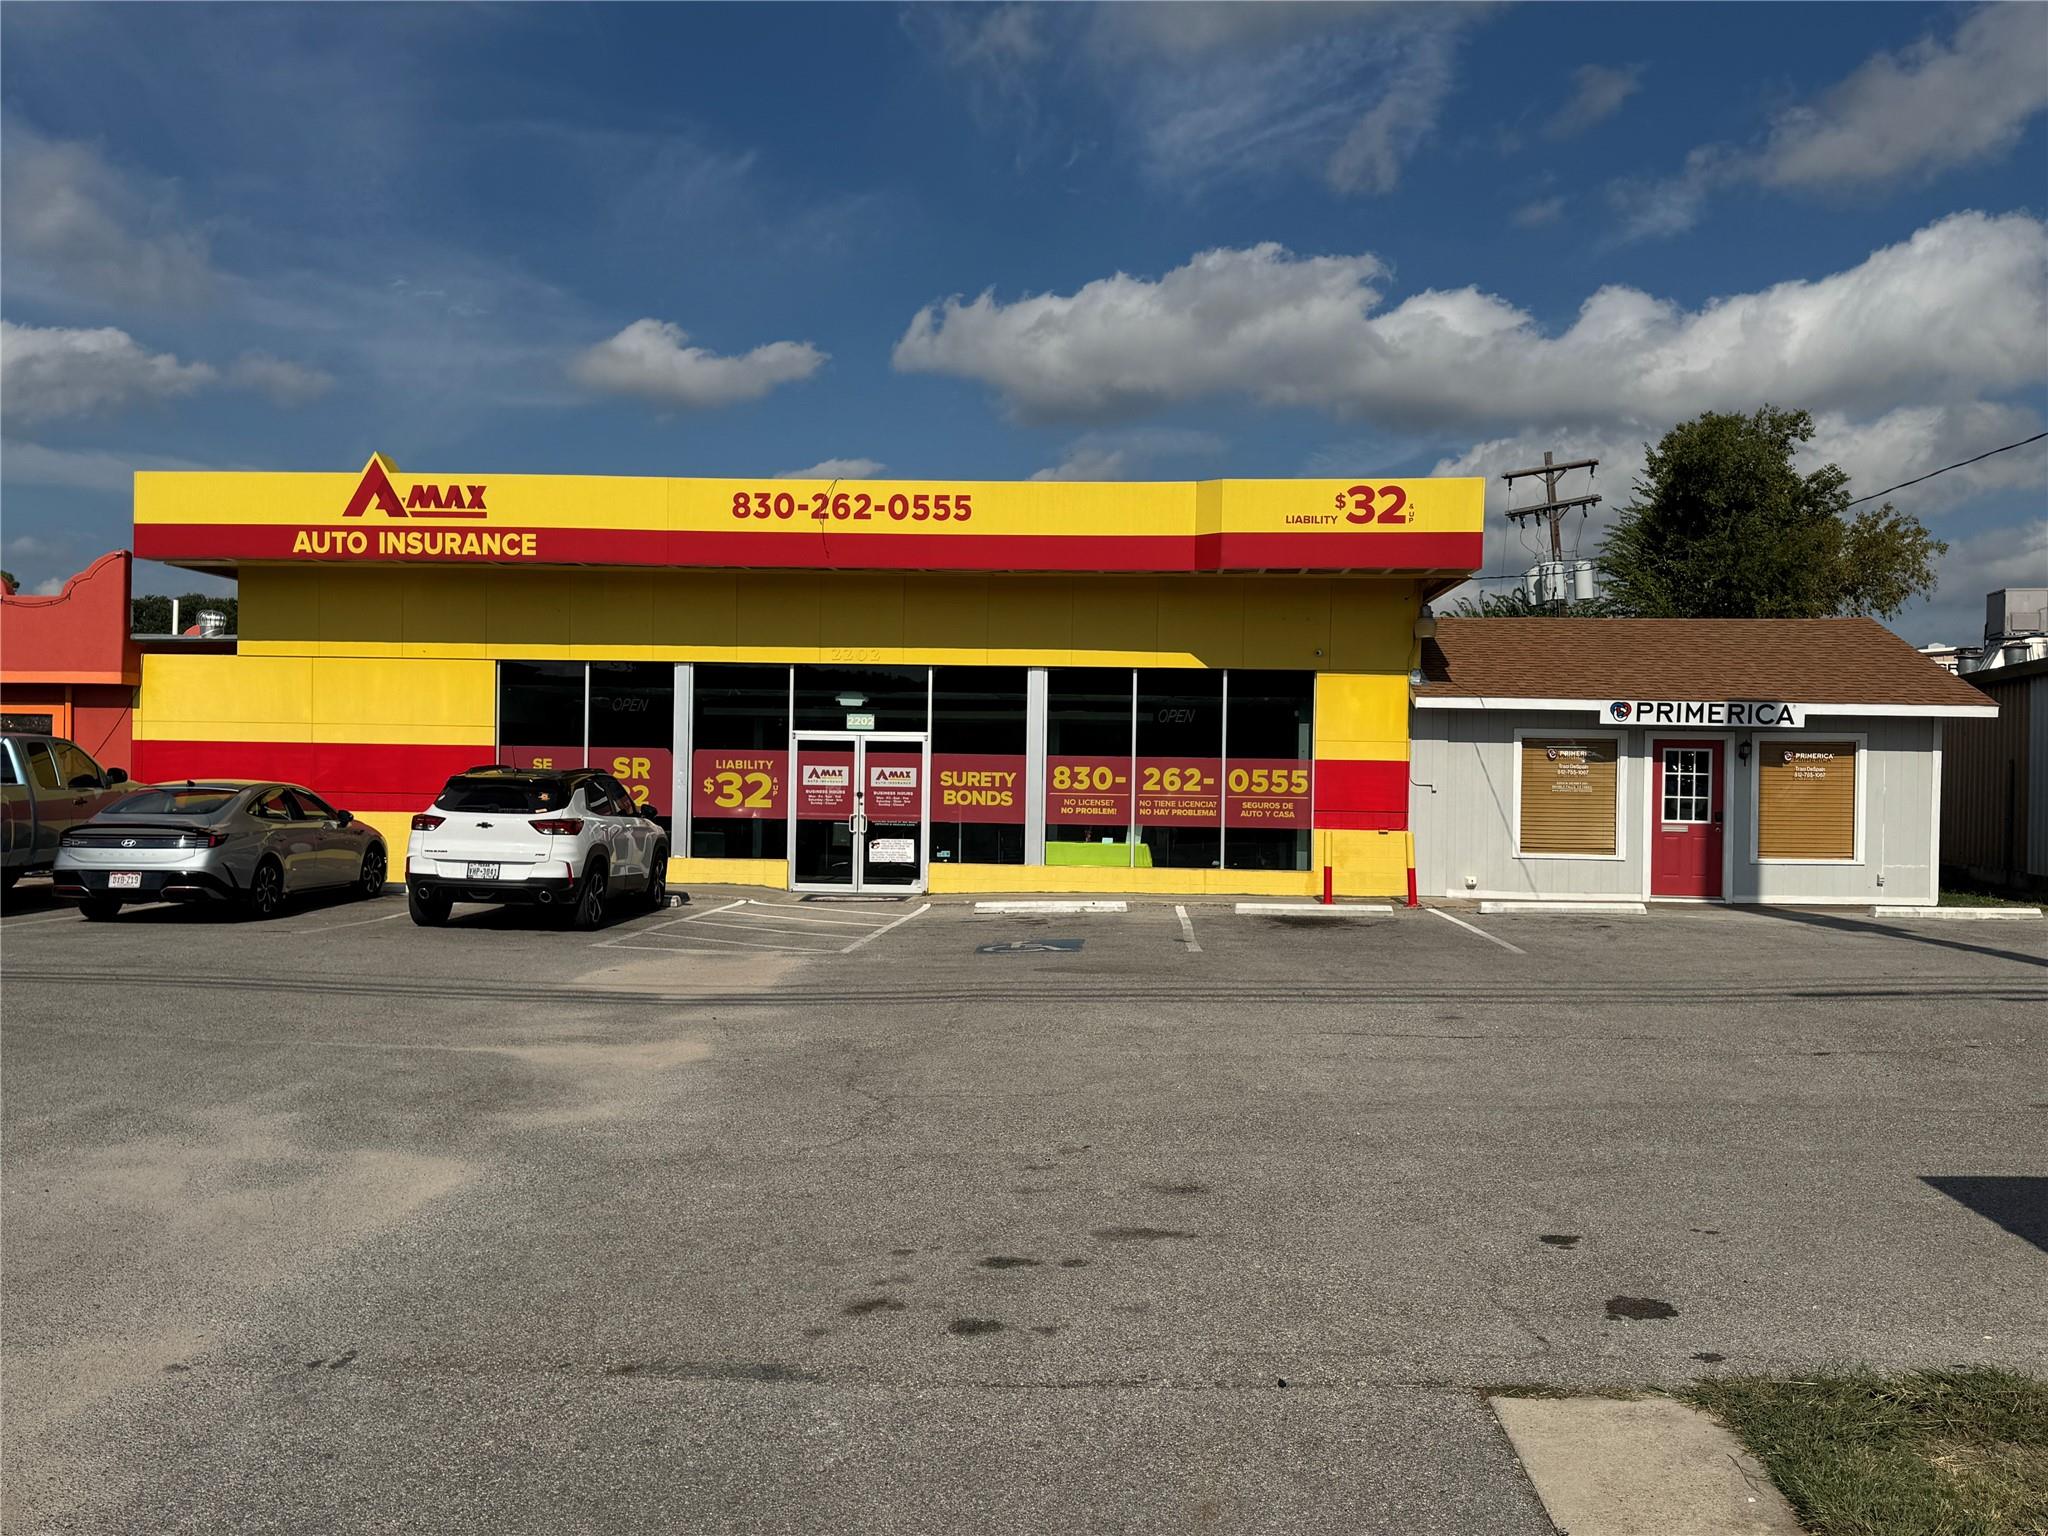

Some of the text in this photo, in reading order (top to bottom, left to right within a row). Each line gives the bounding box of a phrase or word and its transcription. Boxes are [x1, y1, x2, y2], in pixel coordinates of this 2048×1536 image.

[732, 492, 972, 521] 830-262-0555
[1285, 515, 1338, 524] LIABILITY
[293, 531, 537, 555] AUTO INSURANCE
[612, 698, 648, 711] OPEN
[1158, 709, 1195, 723] OPEN
[1636, 702, 1795, 725] PRIMERICA
[848, 717, 873, 725] 2202
[613, 757, 651, 779] SR
[715, 759, 774, 769] LIABILITY
[940, 771, 1017, 787] SURETY
[1053, 766, 1126, 790] 830-
[1142, 768, 1214, 792] 262-
[1228, 769, 1309, 793] 0555
[943, 789, 1013, 807] BONDS
[1063, 798, 1115, 807] NO LICENSE?
[1178, 800, 1217, 808] LICENCIA?
[1241, 801, 1281, 809] SEGUROS
[1075, 807, 1118, 815] PROBLEM!
[1139, 808, 1217, 817] NO HAY PROBLEMA!
